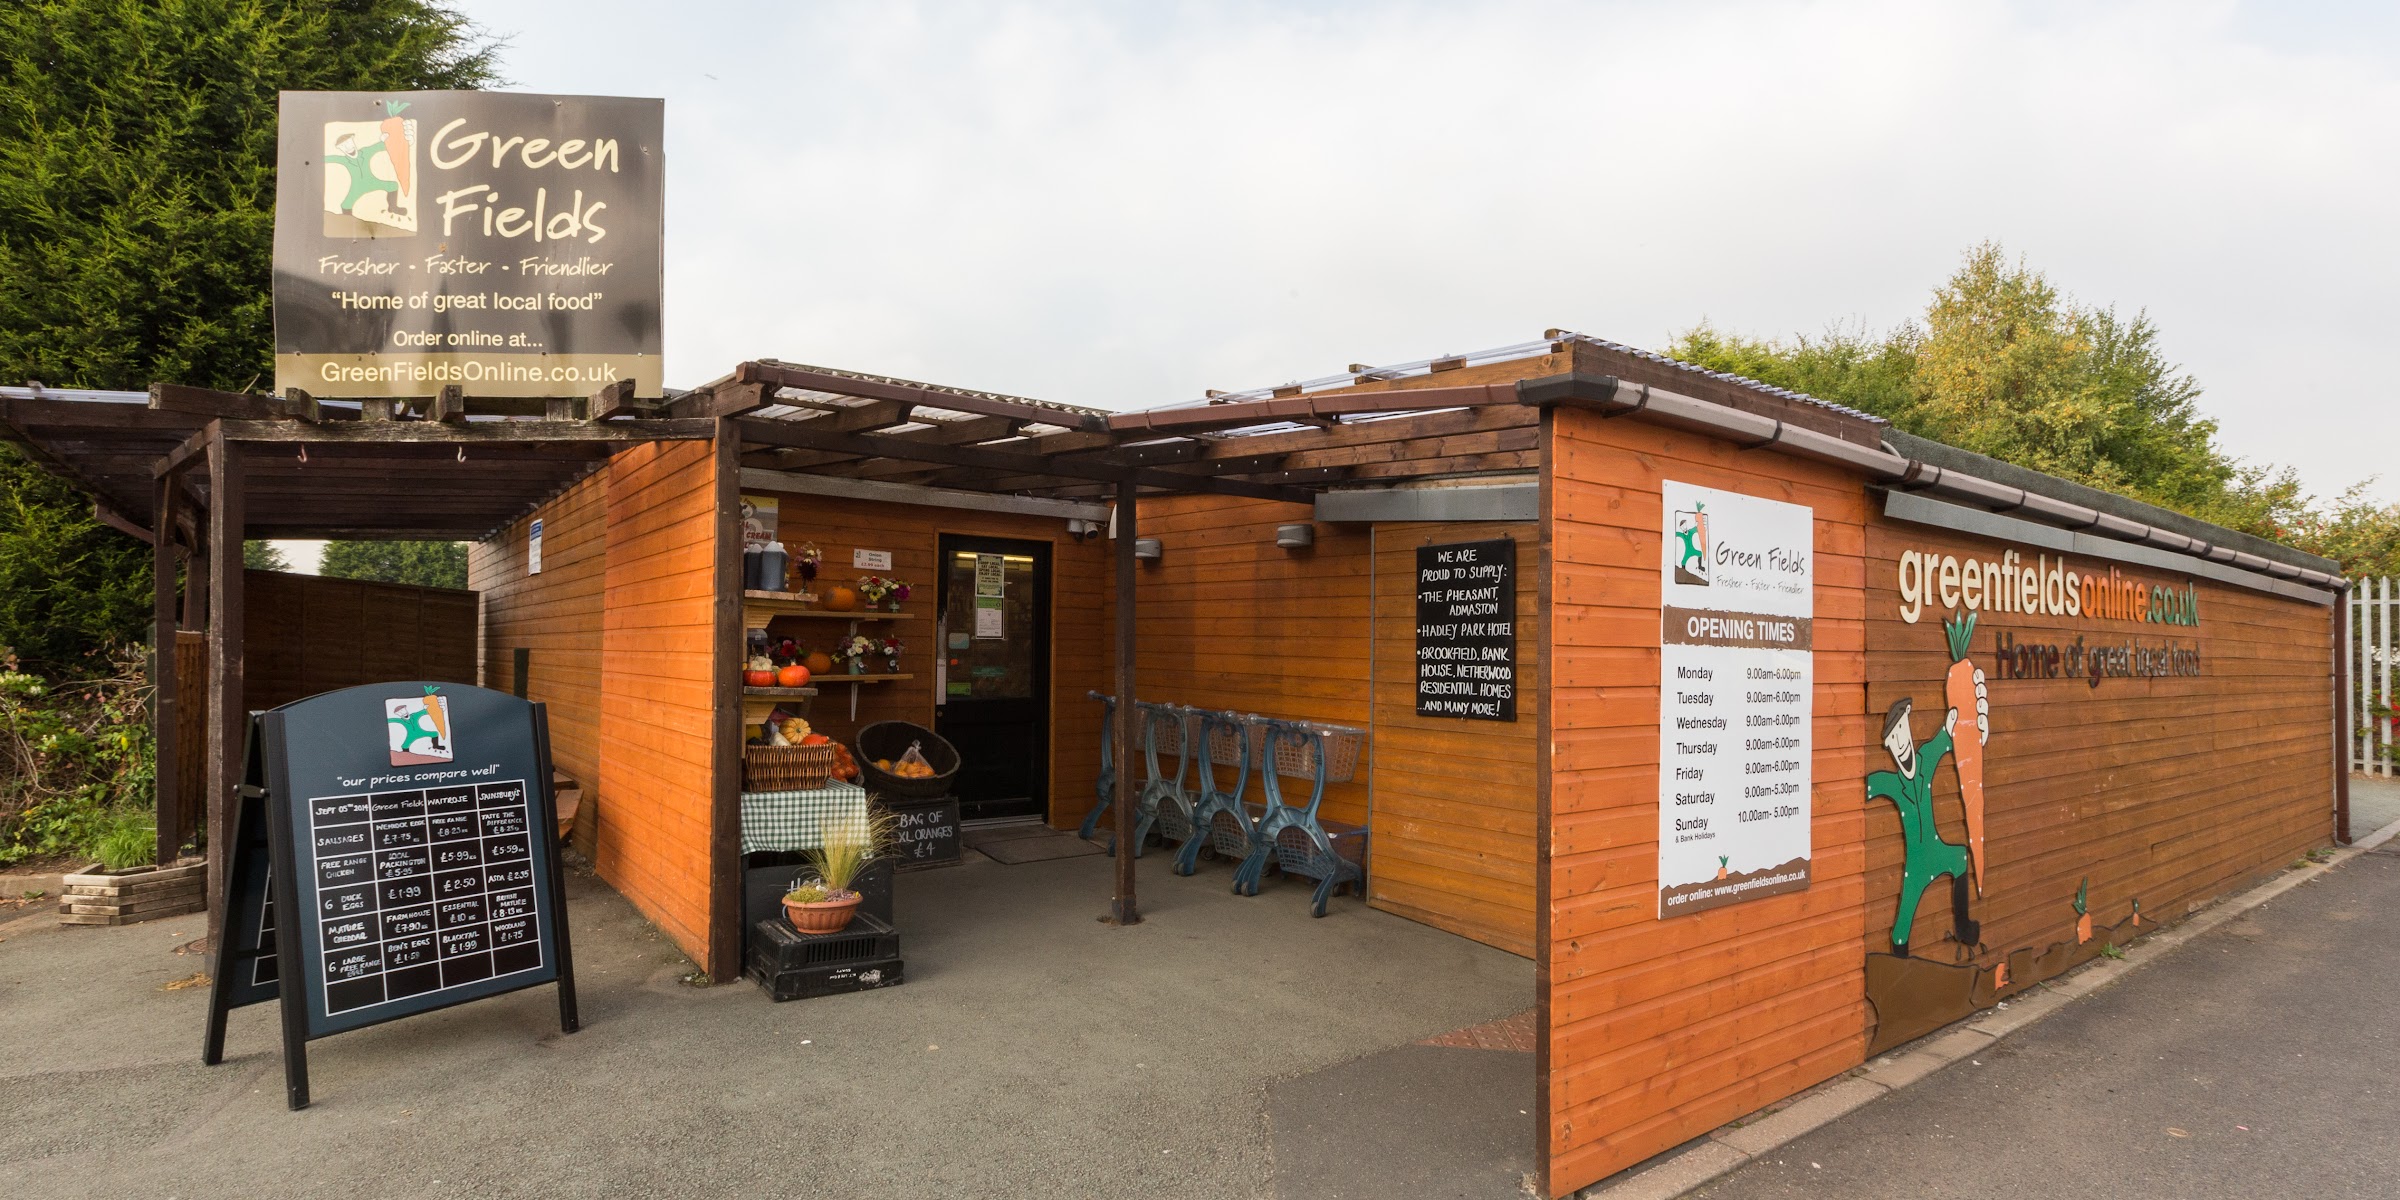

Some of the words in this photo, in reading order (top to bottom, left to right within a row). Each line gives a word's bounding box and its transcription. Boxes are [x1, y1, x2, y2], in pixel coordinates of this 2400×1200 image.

[430, 118, 620, 174] Green
[436, 184, 607, 243] Fields
[318, 254, 400, 277] Fresher
[425, 254, 492, 276] Faster
[520, 256, 614, 277] Friendlier
[409, 292, 428, 310] of
[432, 293, 486, 313] great
[494, 292, 542, 310] local
[393, 330, 442, 347] Order
[447, 330, 503, 347] online
[320, 360, 617, 383] GreenFieldsOnline.co.uk
[746, 531, 772, 540] CREAM
[1438, 551, 1453, 563] WE
[1456, 549, 1477, 562] ARE
[1716, 541, 1762, 570] Green
[1768, 547, 1804, 576] Fields
[1422, 568, 1450, 582] PROUD
[1454, 568, 1466, 579] TO
[1469, 564, 1507, 583] SUPPLY:
[1716, 574, 1743, 588] Fresher
[1750, 578, 1770, 592] Faster
[1778, 581, 1804, 594] Friendlier
[1899, 548, 2200, 626] greenfieldsonline.co.uk
[1422, 591, 1443, 603] THE
[1450, 603, 1498, 616] ADMASTON
[1422, 624, 1457, 640] HADLEY
[1461, 623, 1486, 636] PARK
[1488, 622, 1512, 636] HOTEL
[1687, 616, 1754, 640] OPENING
[1757, 620, 1795, 642] TIMES
[1482, 646, 1509, 661] BANK
[1996, 631, 2058, 681] Home
[2064, 636, 2083, 679] of
[2089, 638, 2131, 688] great
[2135, 637, 2169, 678] local
[2172, 640, 2200, 678] food
[1457, 664, 1512, 680] NETHERWOOD
[1677, 666, 1714, 682] Monday
[1746, 668, 1802, 682] 9.00am-6.00pm
[1420, 680, 1477, 695] RESIDENTIAL
[1480, 682, 1511, 698] HOMES
[1677, 691, 1714, 706] Tuesday
[1746, 691, 1801, 705] 9.00am-6.00pm
[1444, 700, 1470, 715] MANY
[1471, 700, 1500, 716] MORE!
[1676, 716, 1728, 730] Wednesday
[1746, 714, 1800, 728] 9.00am-6.00pm
[1676, 741, 1718, 755] Thursday
[1746, 737, 1800, 751] 9.00am-6.00pm
[1676, 767, 1704, 782] Friday
[1745, 760, 1800, 775] 9.00am-6.00pm
[370, 774, 410, 789] prices
[414, 770, 468, 782] compare
[1744, 782, 1800, 798] 9.00am-5.30pm
[428, 795, 468, 806] WAITROSE
[1676, 791, 1716, 806] Saturday
[315, 806, 336, 816] SEPT
[353, 804, 368, 812] 2014
[371, 802, 398, 812] Green
[400, 800, 424, 809] Fields
[481, 812, 500, 820] TASTE
[900, 812, 924, 828] BAG
[928, 810, 943, 824] OF
[1738, 809, 1772, 823] 10.00am-
[1774, 805, 1800, 818] 5.00pm
[486, 818, 523, 826] DIFFERENCE
[1676, 816, 1708, 832] Sunday
[317, 834, 364, 846] SAUSAGES
[898, 831, 915, 843] XL
[914, 826, 953, 840] ORANGES
[1675, 836, 1679, 844] &
[1680, 834, 1694, 843] Bank
[1694, 832, 1716, 841] Holidays
[388, 852, 410, 860] LOCAL
[320, 860, 342, 870] FREE
[344, 858, 368, 866] RANGE
[380, 858, 426, 870] PACKINGTON
[326, 868, 354, 879] CHICKEN
[488, 875, 505, 884] ASDA
[1668, 893, 1688, 906] order
[1689, 888, 1714, 901] online:
[1714, 869, 1806, 896] www.greenfieldsonline.co.uk
[324, 899, 334, 910] 6
[340, 892, 363, 903] DUCK
[342, 902, 364, 911] EGGS
[442, 901, 480, 912] ESSENTIAL
[328, 922, 366, 935] MATURE
[494, 920, 527, 932] WOODLAND
[333, 932, 368, 944] CHEDDAR
[412, 938, 430, 948] EGGS
[442, 930, 480, 944] BLACKTAIL
[340, 964, 358, 974] FREE
[360, 959, 382, 969] RANGE
[342, 954, 366, 965] LARGE
[328, 962, 336, 972] 6
